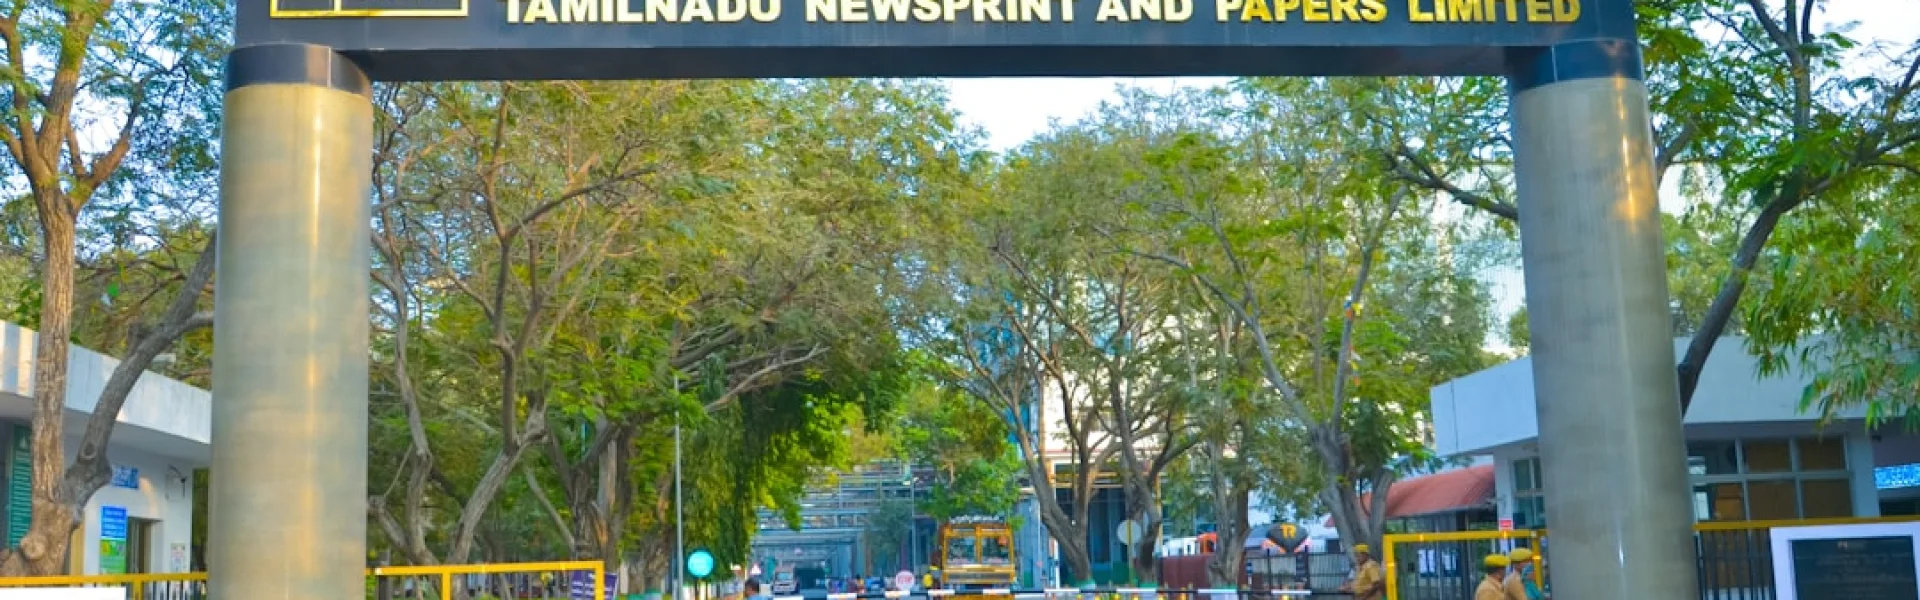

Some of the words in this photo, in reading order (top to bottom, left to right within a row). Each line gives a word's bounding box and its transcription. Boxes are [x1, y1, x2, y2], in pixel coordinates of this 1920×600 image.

[506, 0, 781, 23] TAMILNADU
[806, 0, 1074, 22] NEWSPRINT
[1096, 0, 1192, 22] AND
[1216, 0, 1388, 22] PAPERS
[1408, 0, 1581, 22] LIMITED
